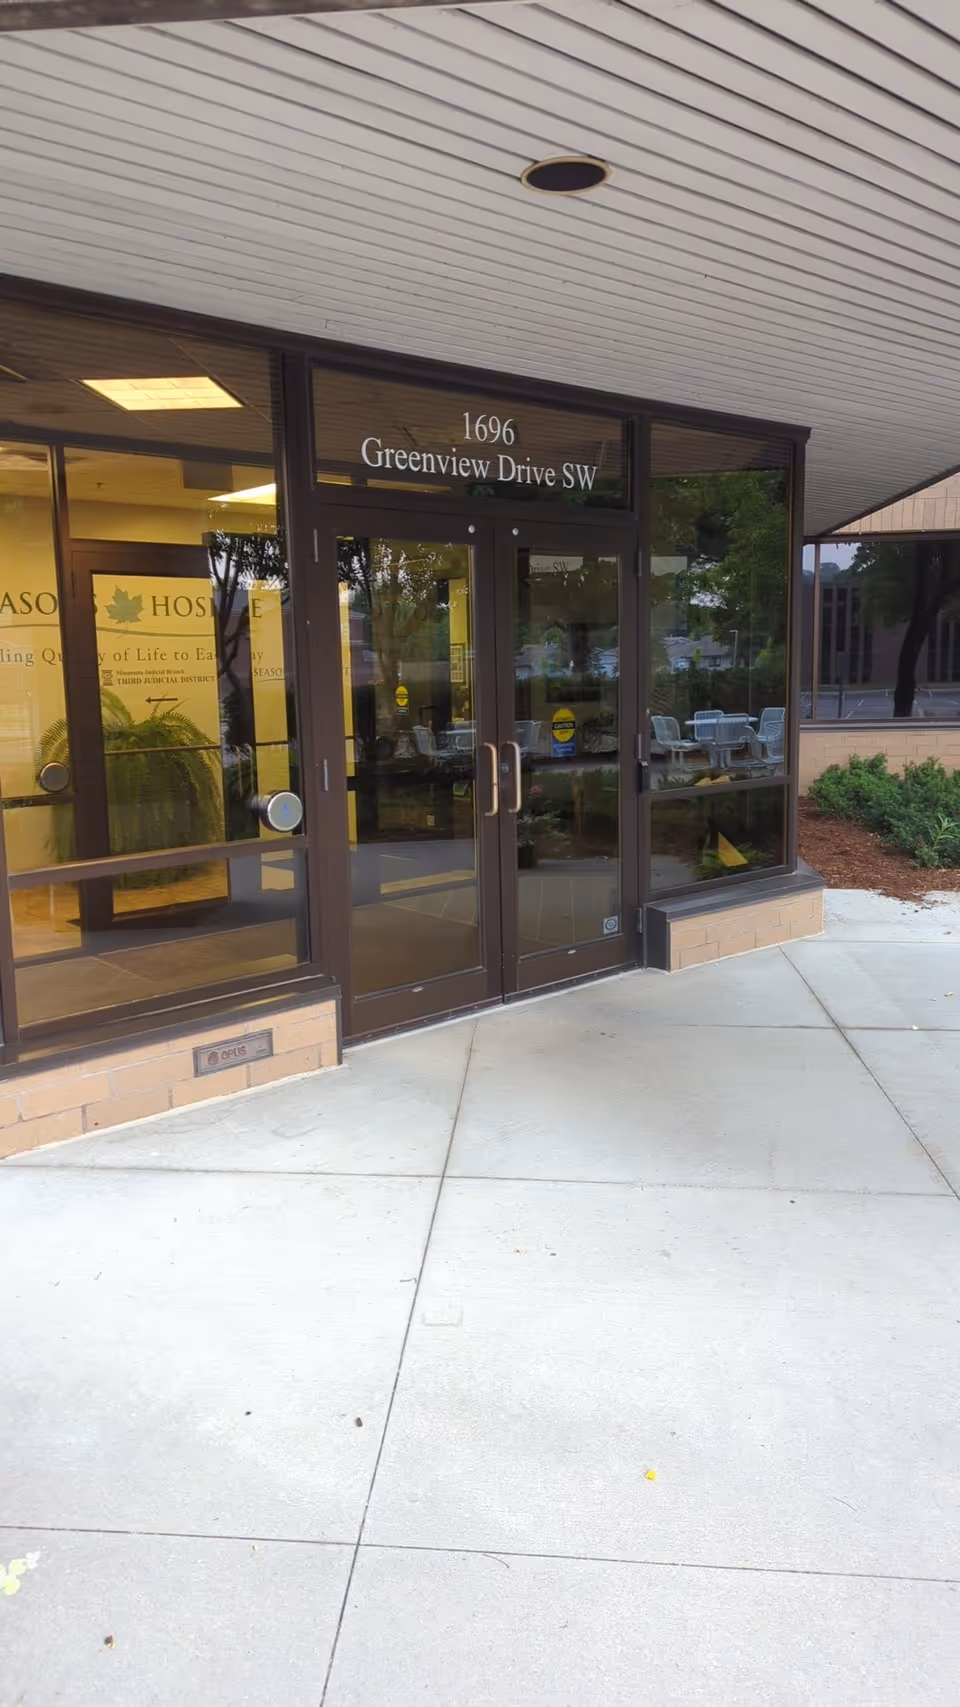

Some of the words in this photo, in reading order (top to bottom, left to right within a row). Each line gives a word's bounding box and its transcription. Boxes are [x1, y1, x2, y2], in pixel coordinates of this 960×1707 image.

[463, 412, 515, 445] 1696
[361, 437, 490, 479] Greenview
[497, 454, 556, 487] Drive
[562, 463, 597, 491] SW
[151, 595, 263, 618] HOSE
[113, 648, 131, 661] of
[136, 648, 168, 661] Life
[174, 650, 189, 661] to
[253, 667, 284, 677] SEASO
[143, 677, 180, 685] JUDICIAL
[180, 675, 216, 684] DISTRICT
[221, 1046, 246, 1060] OPUS
